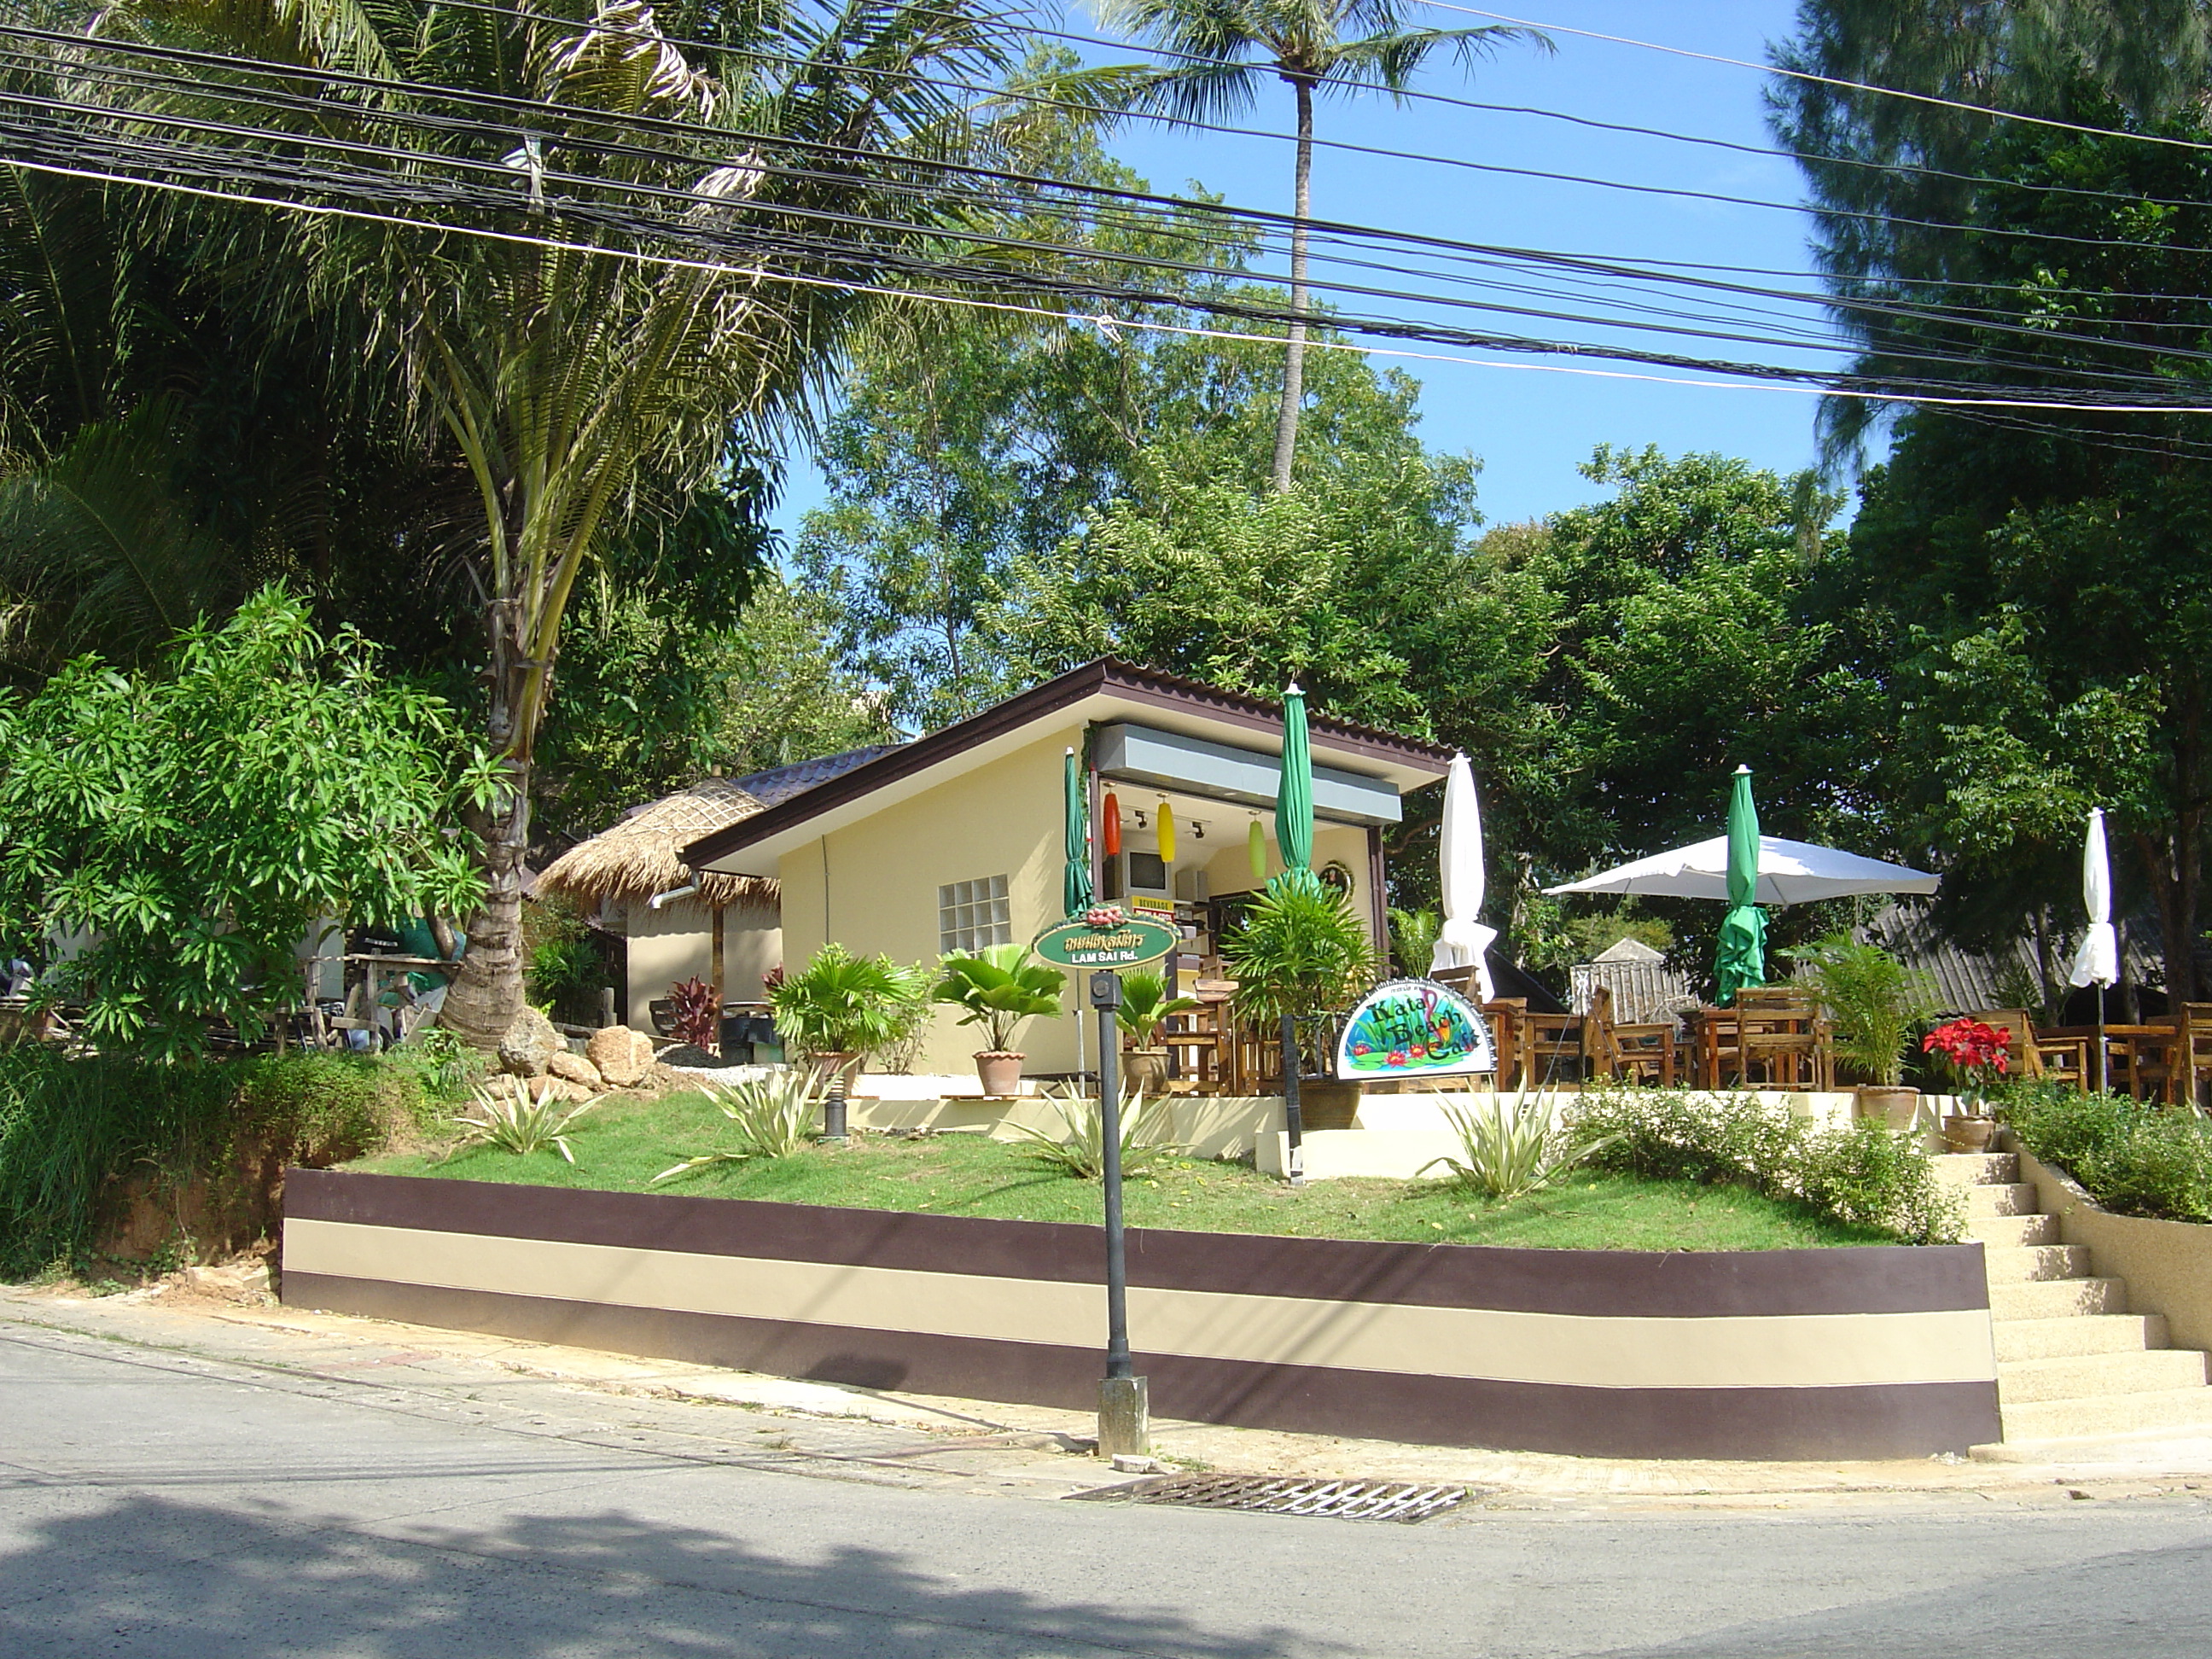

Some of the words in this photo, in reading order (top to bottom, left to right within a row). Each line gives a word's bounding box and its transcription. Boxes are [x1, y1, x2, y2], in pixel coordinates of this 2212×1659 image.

[1139, 899, 1169, 911] BEVERAGE
[1072, 952, 1097, 963] LAM
[1098, 951, 1118, 962] SAI
[1120, 950, 1138, 961] Rd.
[1366, 998, 1427, 1023] Kata
[1387, 1010, 1463, 1045] Beach
